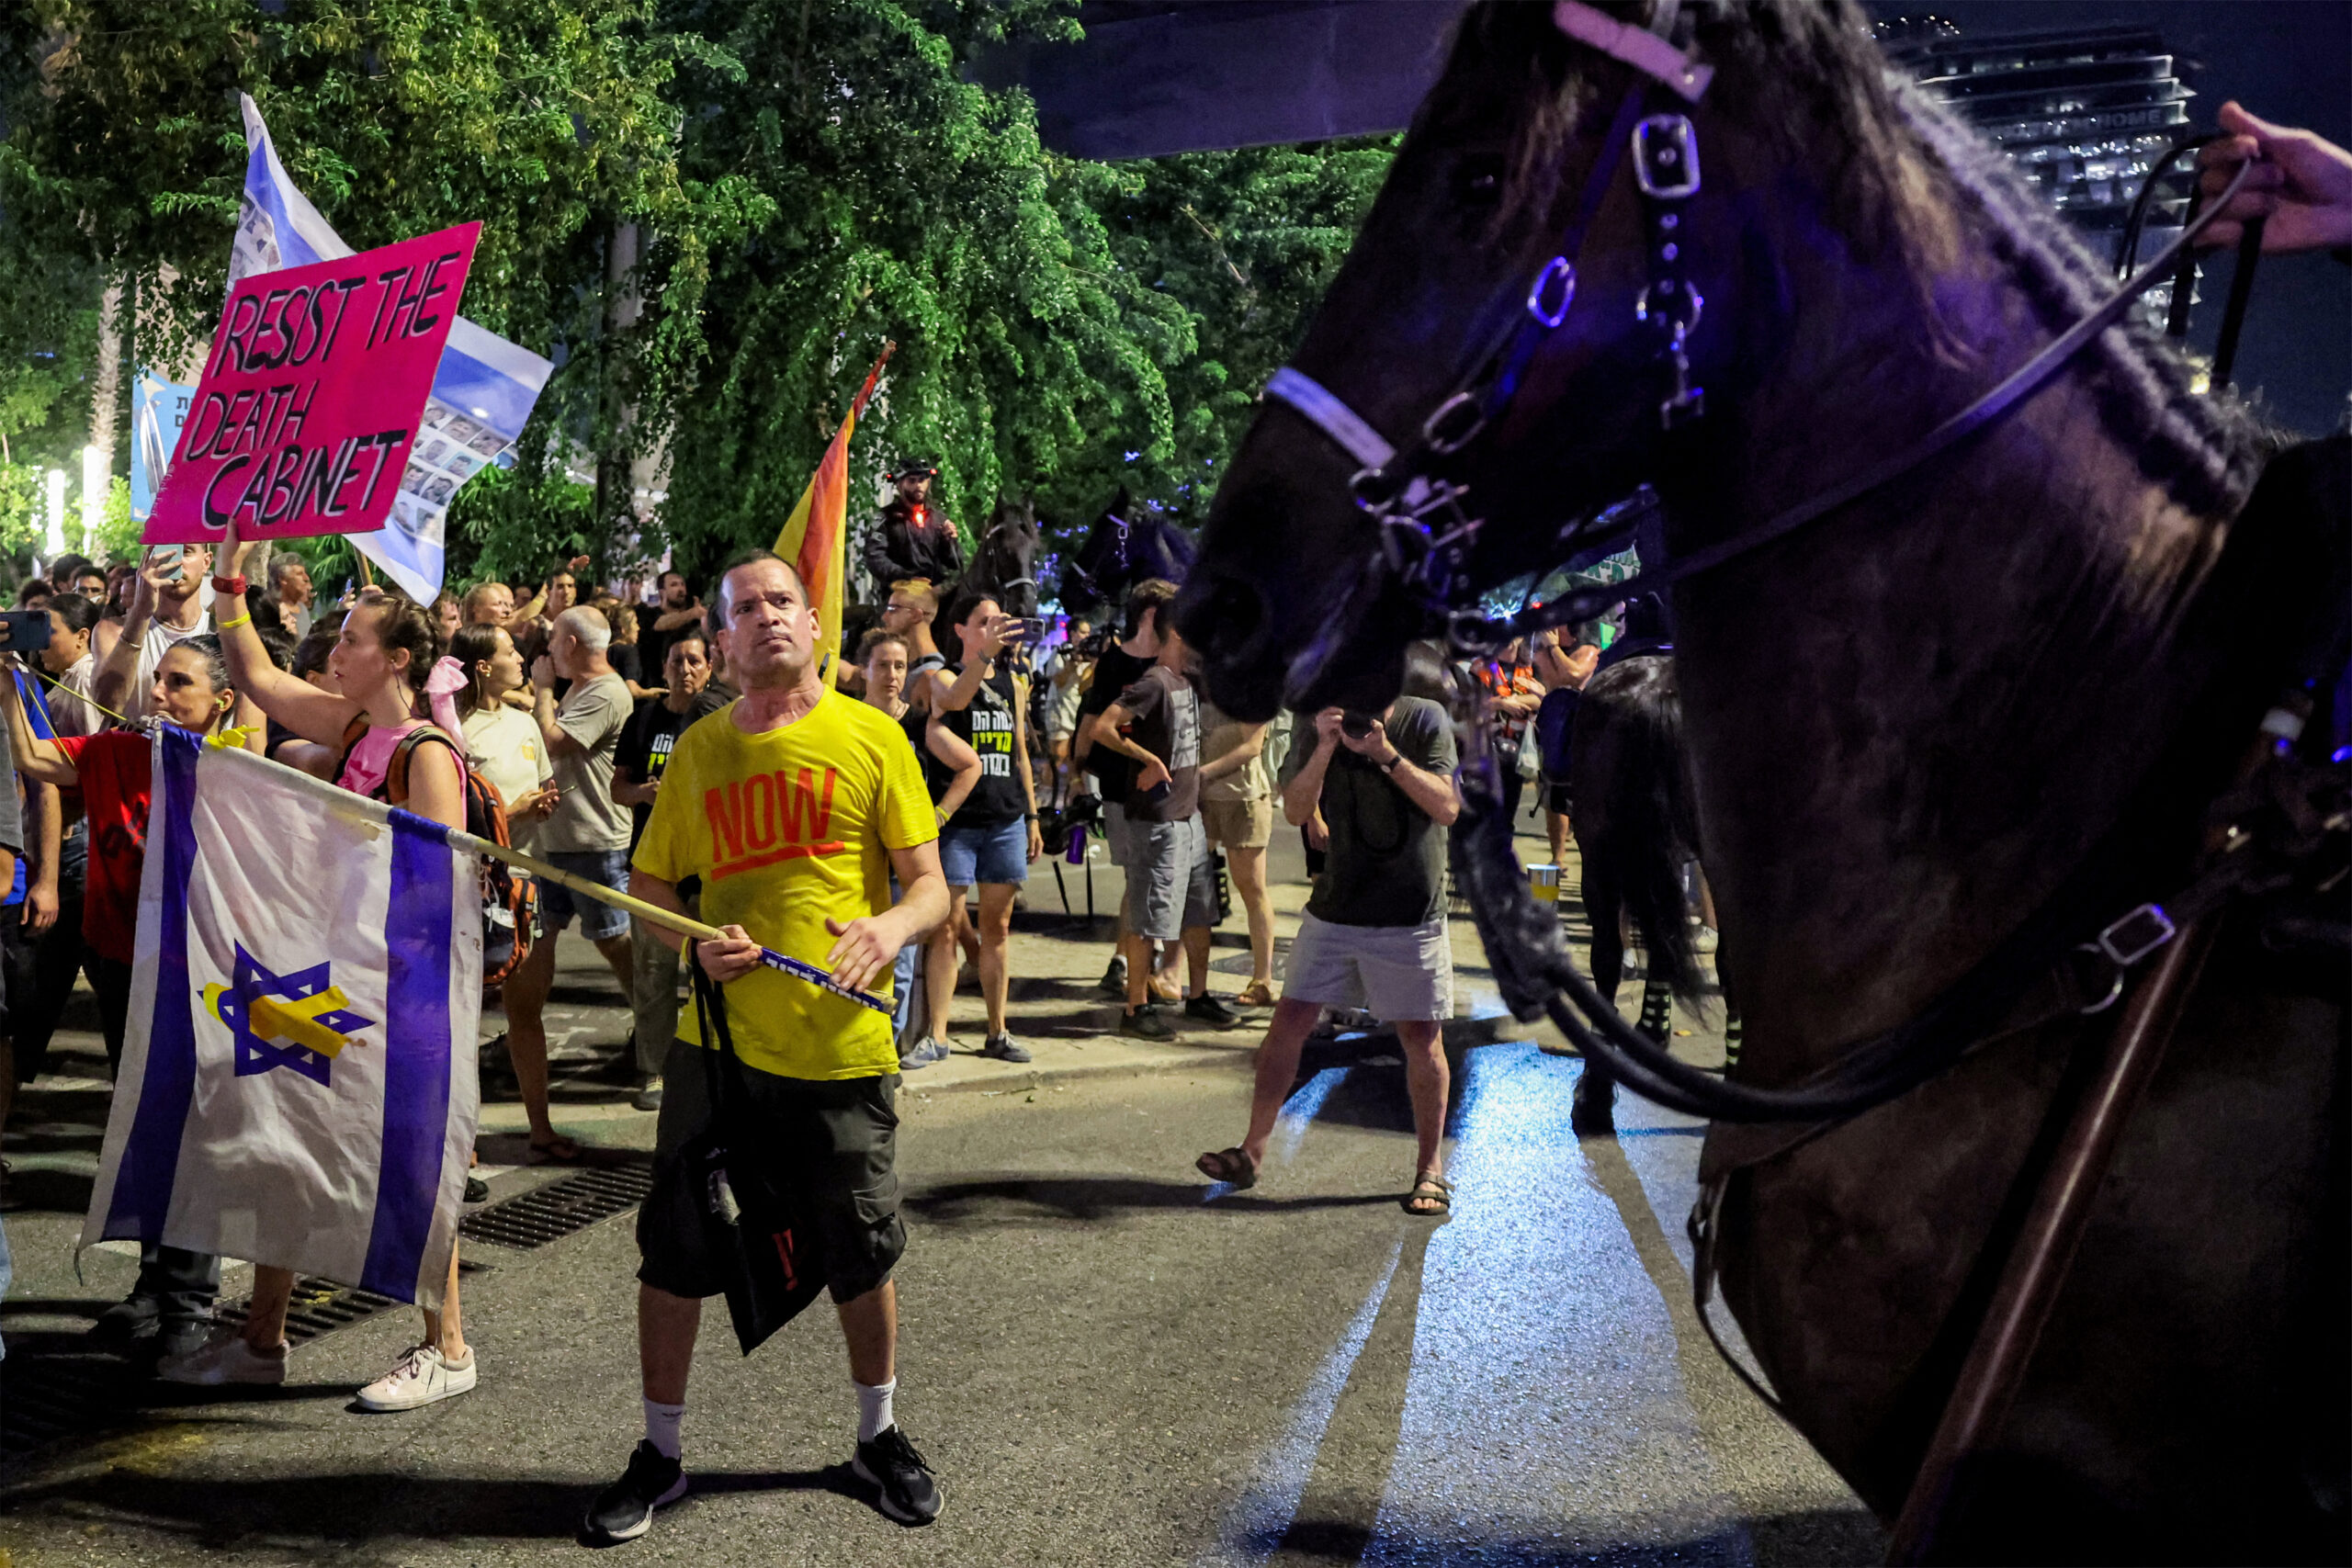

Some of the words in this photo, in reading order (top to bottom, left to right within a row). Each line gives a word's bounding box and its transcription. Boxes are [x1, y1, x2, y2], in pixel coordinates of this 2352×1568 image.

[213, 277, 366, 378] RESIST
[366, 252, 461, 350] THE
[186, 379, 319, 461] DEATH
[202, 429, 407, 529] CABINET
[704, 768, 837, 863] NOW
